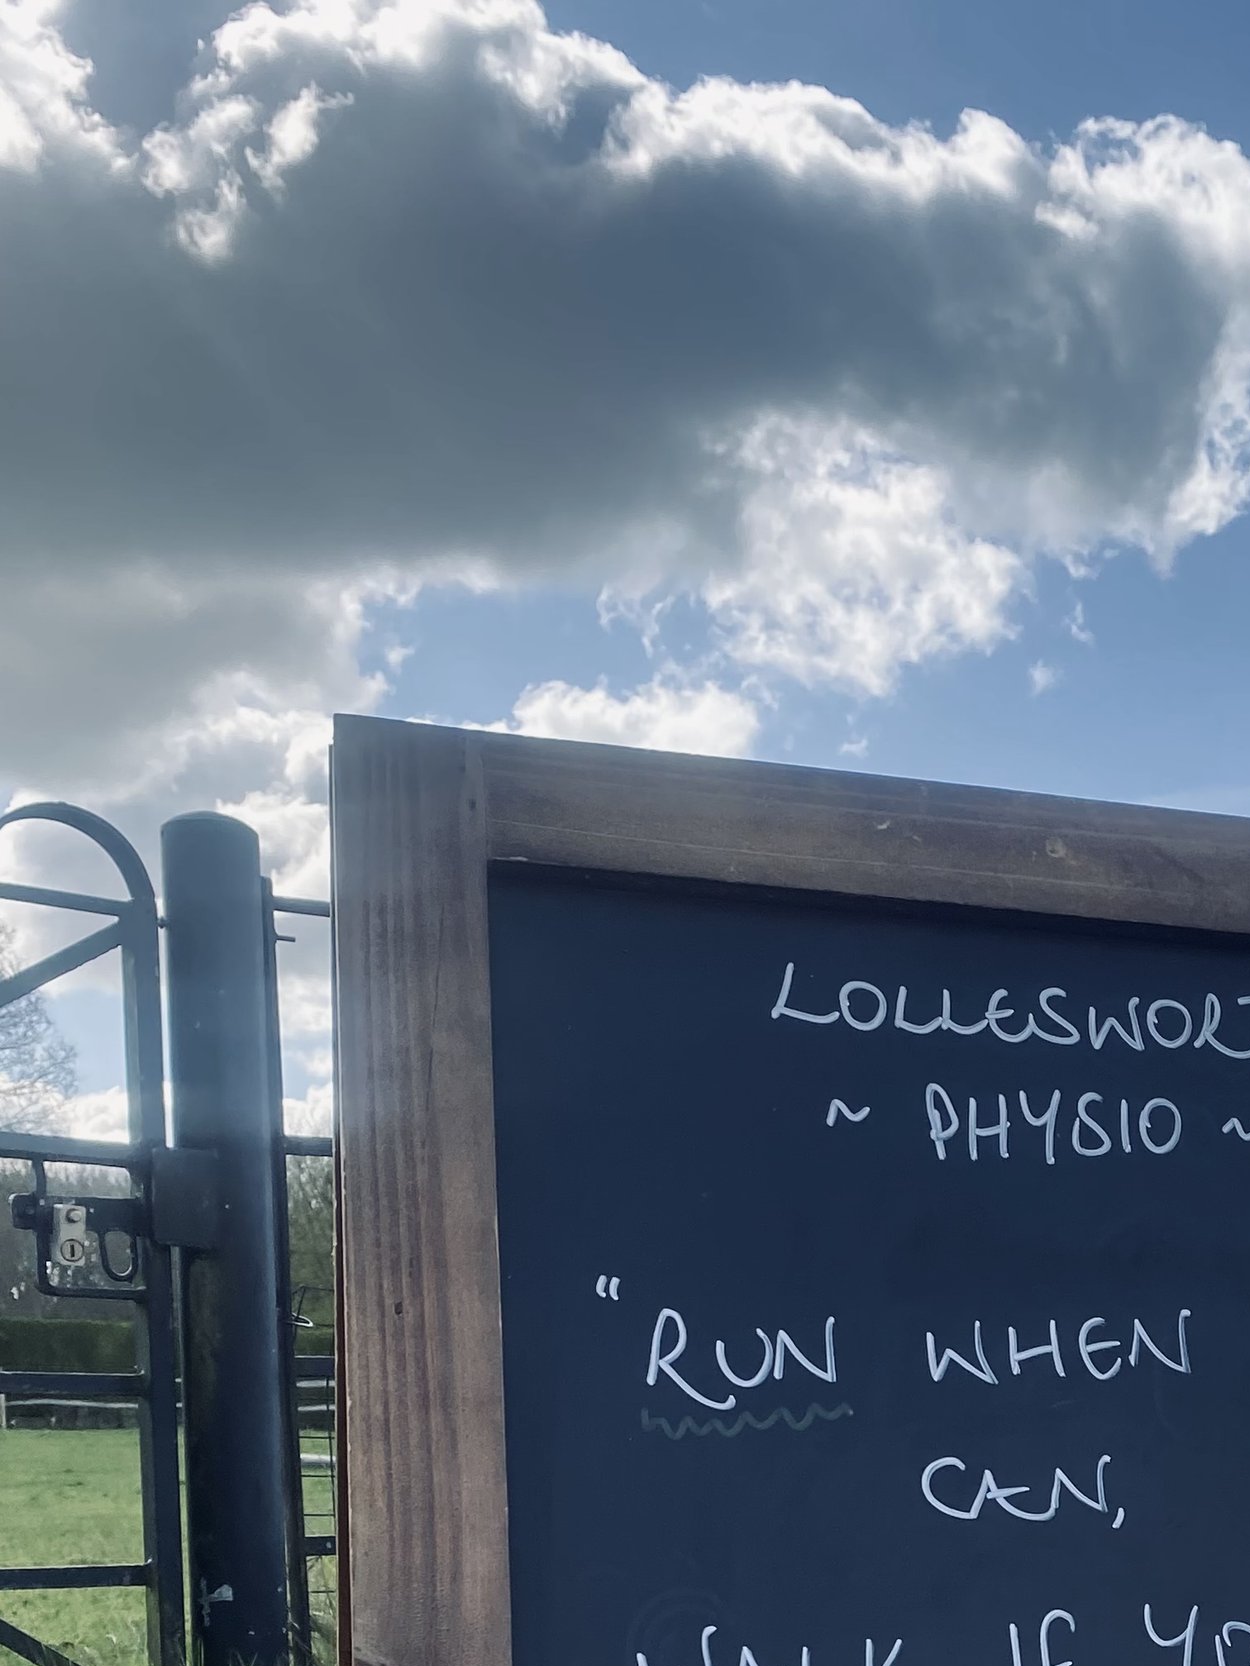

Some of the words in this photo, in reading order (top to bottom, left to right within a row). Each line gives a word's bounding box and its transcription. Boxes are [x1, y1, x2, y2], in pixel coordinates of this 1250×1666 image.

[925, 1082, 1182, 1165] PHYSIO
[925, 1308, 1192, 1385] WHEN
[921, 1454, 1125, 1529] CAN,
